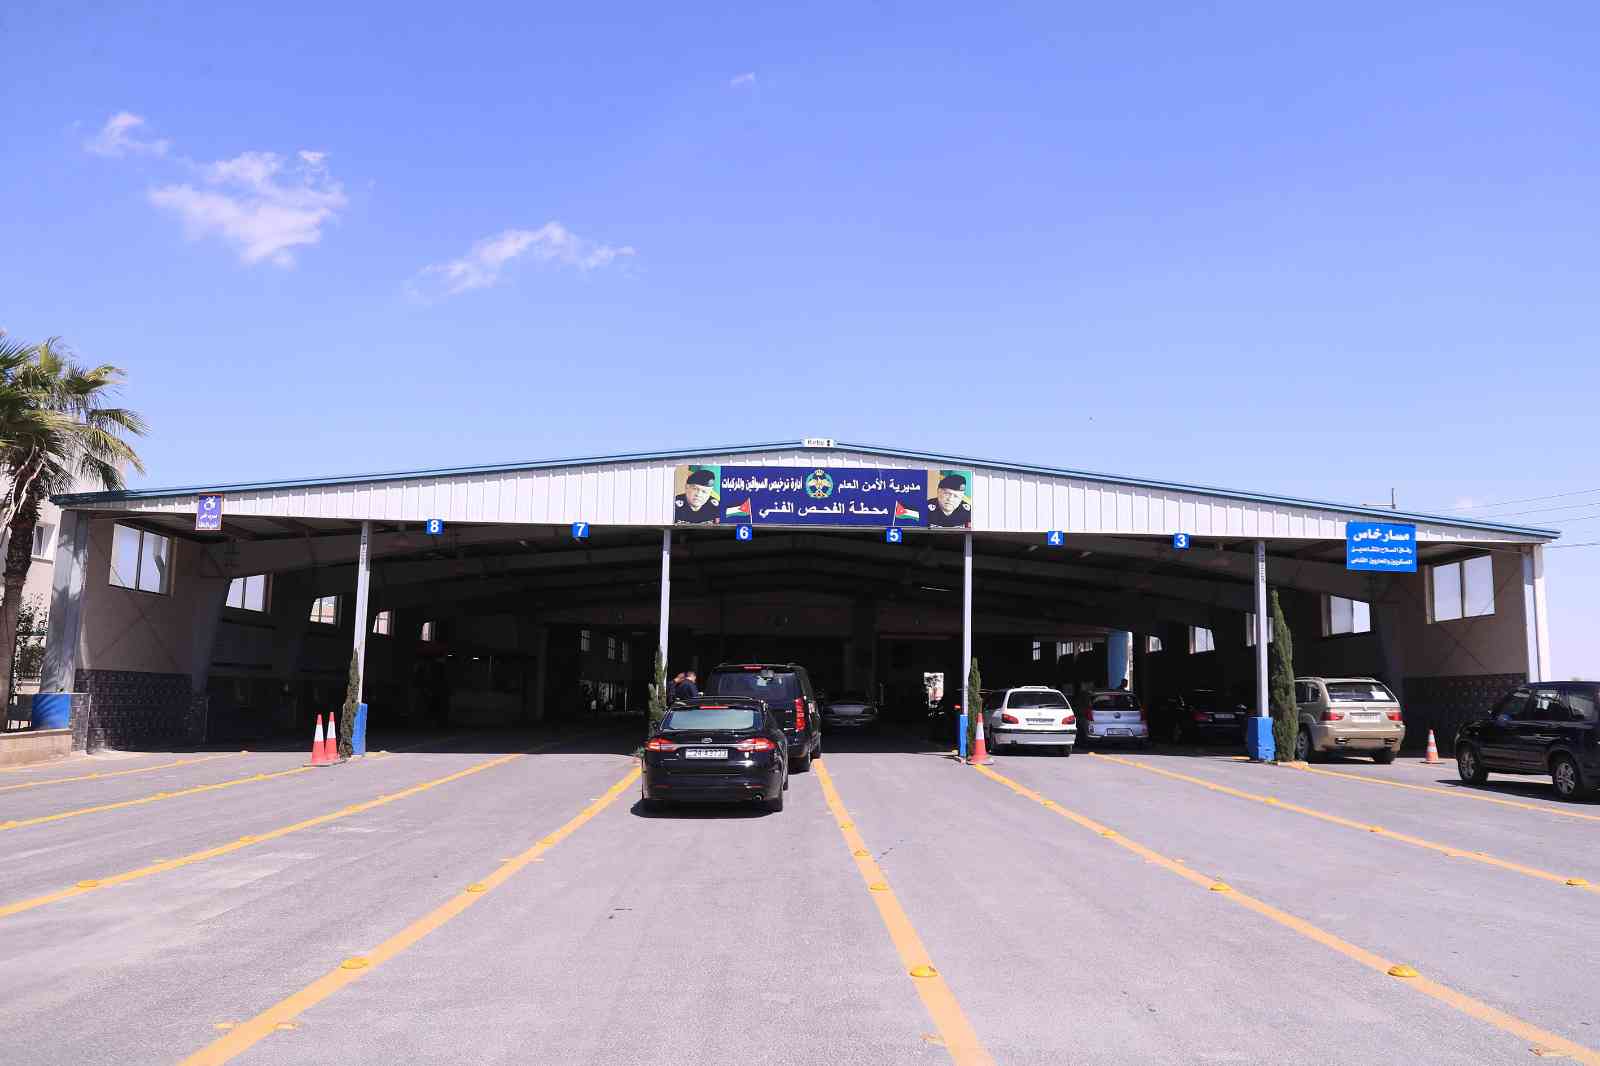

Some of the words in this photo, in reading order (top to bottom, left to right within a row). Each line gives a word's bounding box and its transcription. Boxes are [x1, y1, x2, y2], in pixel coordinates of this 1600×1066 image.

[721, 476, 745, 492] والمركبات
[745, 476, 769, 493] السواقين
[769, 477, 790, 493] ترخيص
[838, 479, 859, 494] العام
[862, 478, 886, 492] الأمن
[889, 479, 921, 493] مديرية
[759, 501, 794, 519] الفني
[798, 502, 845, 517] الفحص
[849, 501, 889, 515] محطة
[430, 519, 439, 533] 8
[577, 523, 586, 536] 7
[739, 526, 749, 540] 6
[889, 529, 899, 542] 5
[1050, 532, 1060, 545] 4
[1177, 534, 1186, 547] 3
[1353, 528, 1382, 542] خاص
[1382, 529, 1410, 542] مسار
